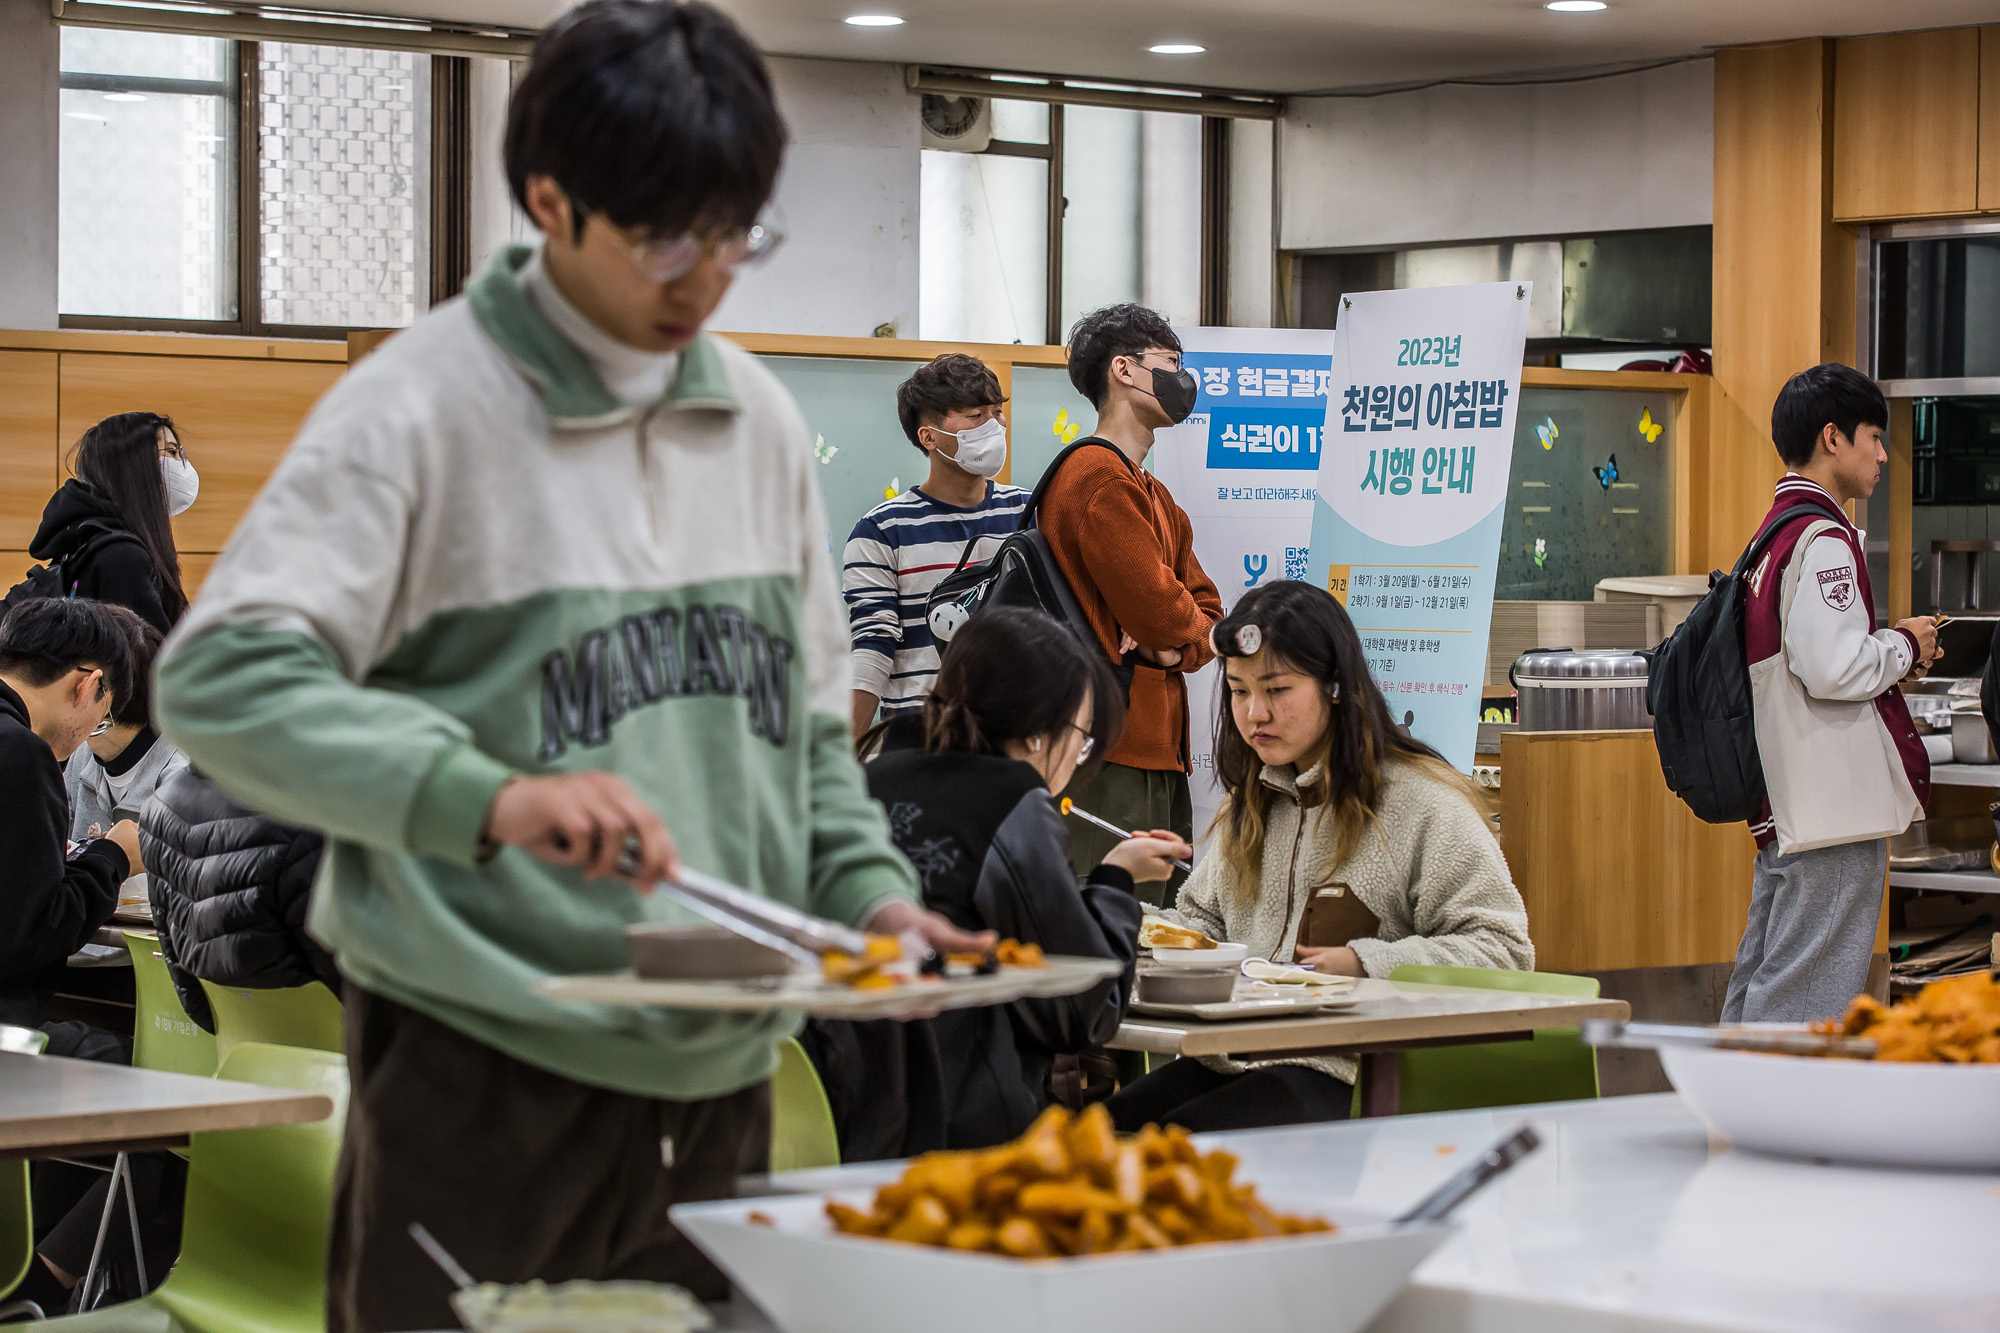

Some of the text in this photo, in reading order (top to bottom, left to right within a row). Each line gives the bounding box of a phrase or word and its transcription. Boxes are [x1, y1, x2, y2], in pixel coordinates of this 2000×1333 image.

[1397, 335, 1461, 367] 2023년
[1342, 379, 1509, 432] 천원의 아침밥
[1220, 423, 1299, 453] 식권이
[1360, 446, 1476, 495] 시행 안내
[1217, 487, 1229, 500] 잘
[1232, 488, 1253, 500] 보고
[1819, 569, 1850, 579] KOREA
[1331, 579, 1347, 592] 기간
[1353, 575, 1373, 587] 1학기
[1378, 575, 1391, 588] 3월
[1391, 575, 1420, 588] 20일(월)
[1427, 576, 1440, 589] 6월
[1441, 576, 1471, 589] 21일(수)
[1350, 595, 1371, 607] 2학기
[1375, 595, 1389, 608] 9월
[1390, 595, 1414, 609] 1일(금)
[1422, 596, 1438, 609] 12월
[1439, 596, 1469, 609] 21일(목)
[1386, 639, 1408, 652] 재학생
[1410, 639, 1417, 652] 및
[1418, 639, 1441, 653] 휴학생
[1378, 659, 1396, 672] 기준)
[1382, 680, 1395, 693] 필수
[1413, 682, 1428, 694] 확인
[1428, 682, 1435, 694] 후
